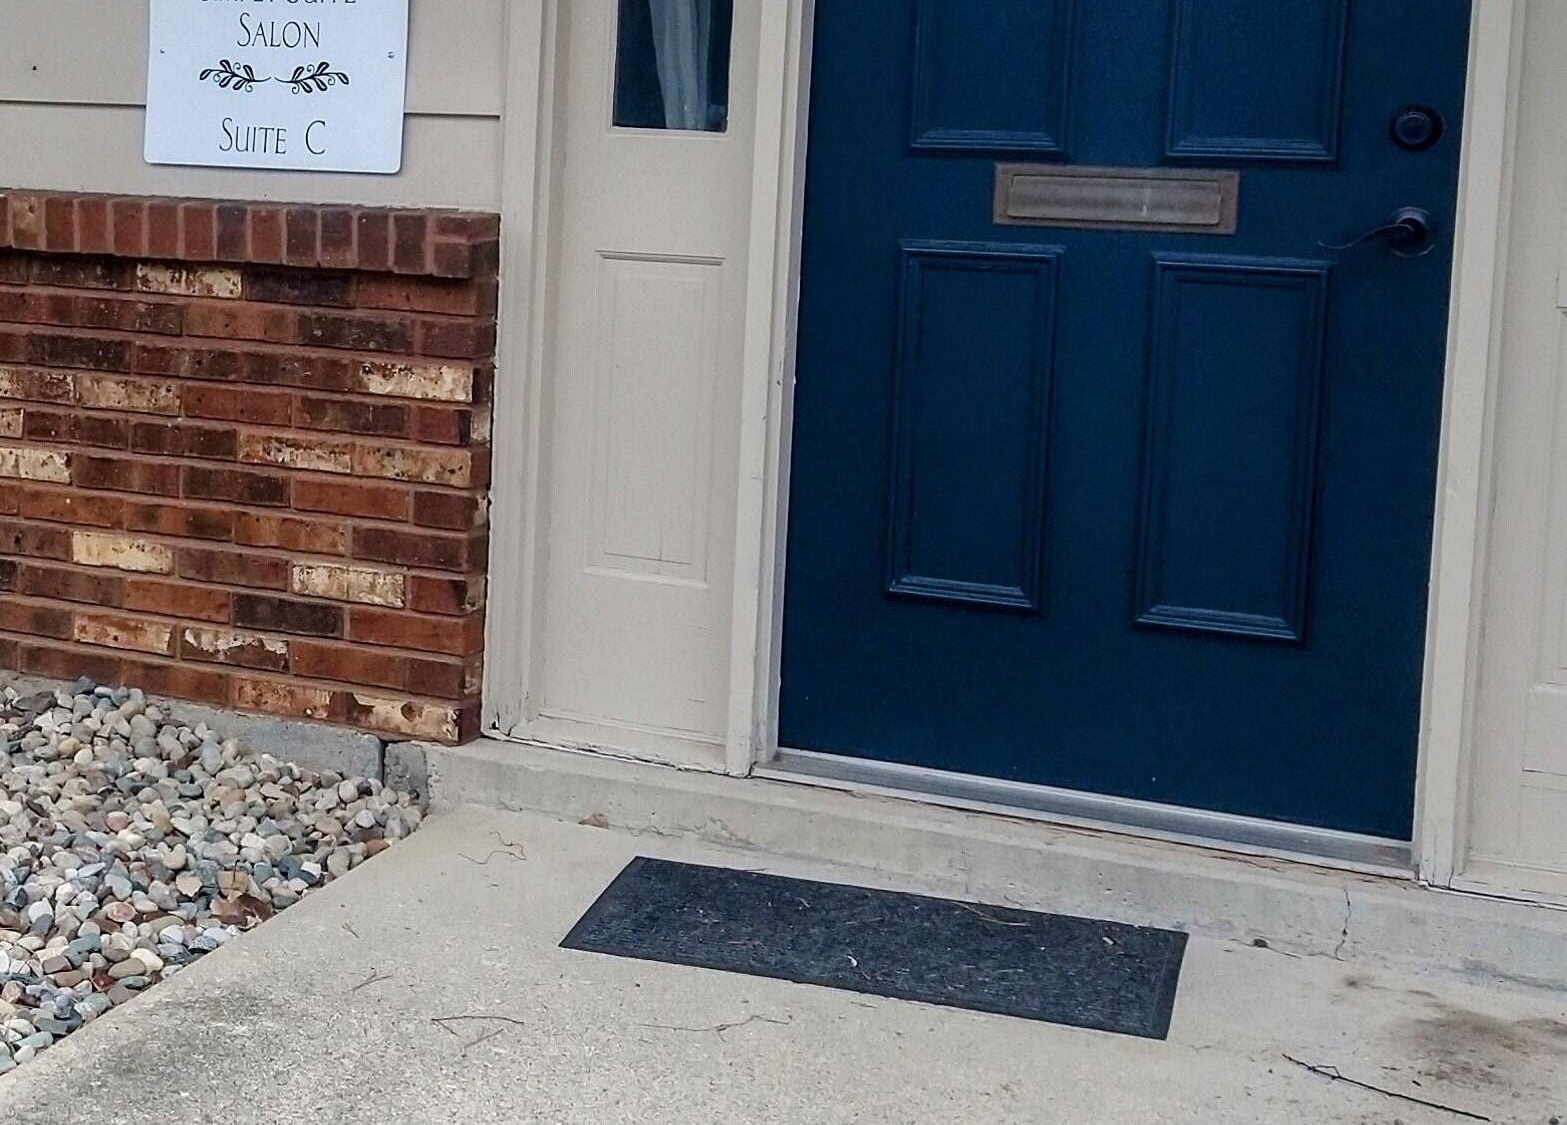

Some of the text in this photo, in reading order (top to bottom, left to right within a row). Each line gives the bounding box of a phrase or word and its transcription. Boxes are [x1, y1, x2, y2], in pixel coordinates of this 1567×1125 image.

[236, 12, 321, 49] SALON
[218, 117, 327, 155] SUITE C
